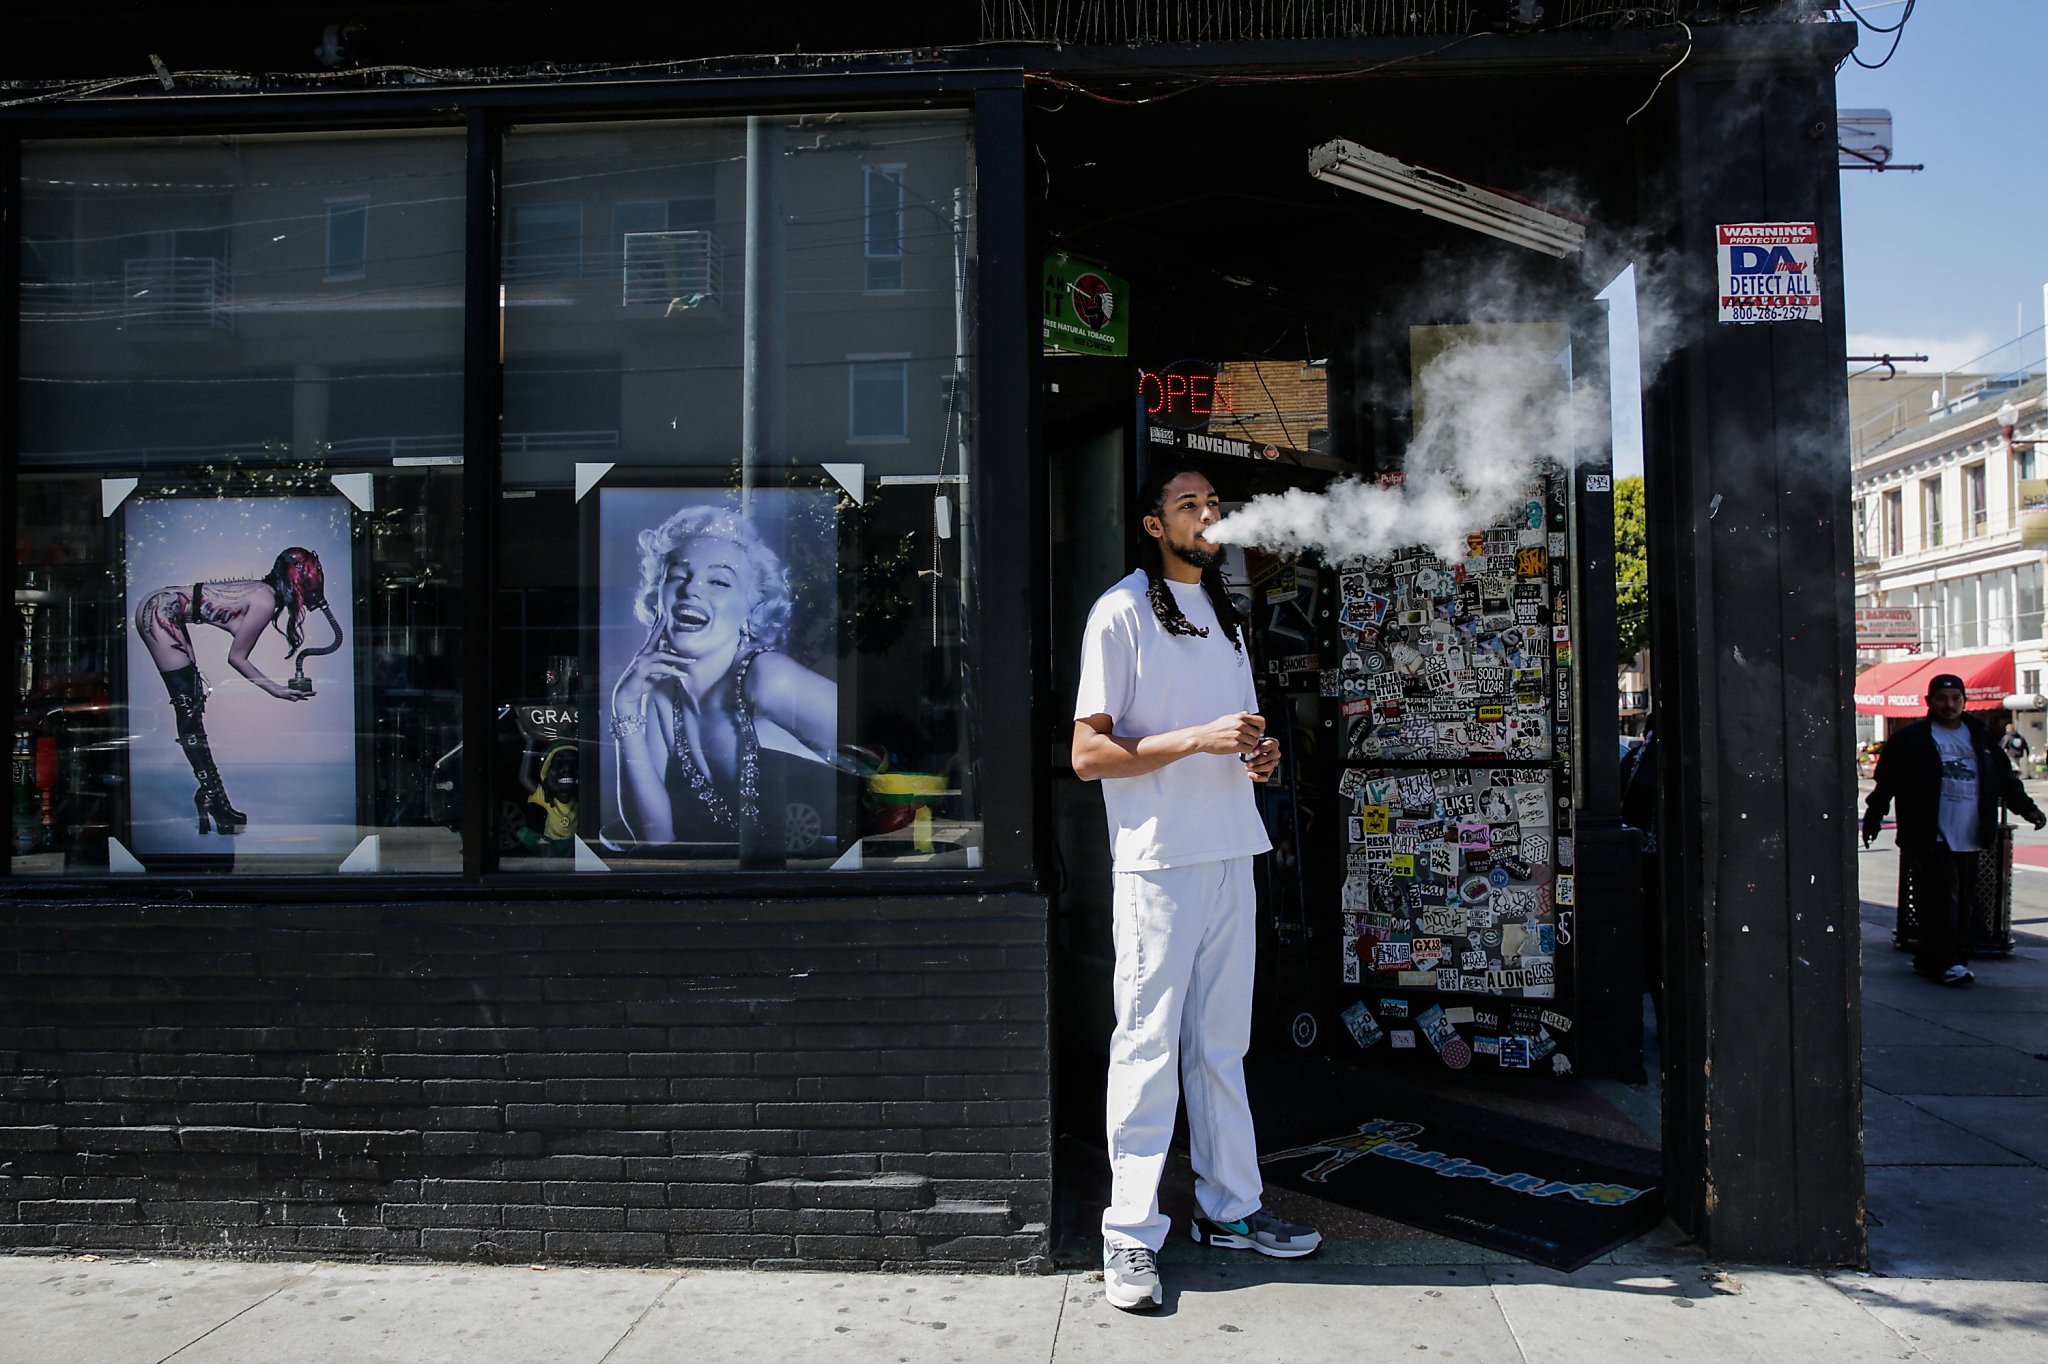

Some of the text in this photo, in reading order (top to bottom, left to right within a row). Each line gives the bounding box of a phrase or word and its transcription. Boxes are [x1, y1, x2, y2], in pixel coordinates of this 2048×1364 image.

[1723, 227, 1812, 236] WARNING
[1730, 246, 1803, 275] DA
[1731, 275, 1811, 295] DETECT ALL
[1733, 308, 1808, 320] 800-286-2527
[1043, 319, 1116, 343] FREE NATURAL TOBACCO
[1138, 372, 1233, 413] OPEN
[1188, 433, 1251, 458] RAYGAME
[1477, 668, 1504, 680] SODUH
[1478, 680, 1504, 694] YU246
[1558, 672, 1568, 708] PUSH
[1888, 695, 1919, 706] PRODUCE
[1444, 795, 1473, 811] LIKE
[1367, 836, 1391, 847] RESK
[1368, 849, 1392, 860] DFM
[1396, 867, 1411, 875] CB
[1437, 969, 1457, 980] MELS
[1533, 963, 1552, 978] UGS
[1440, 979, 1456, 990] SWS
[1487, 970, 1533, 988] ALONG
